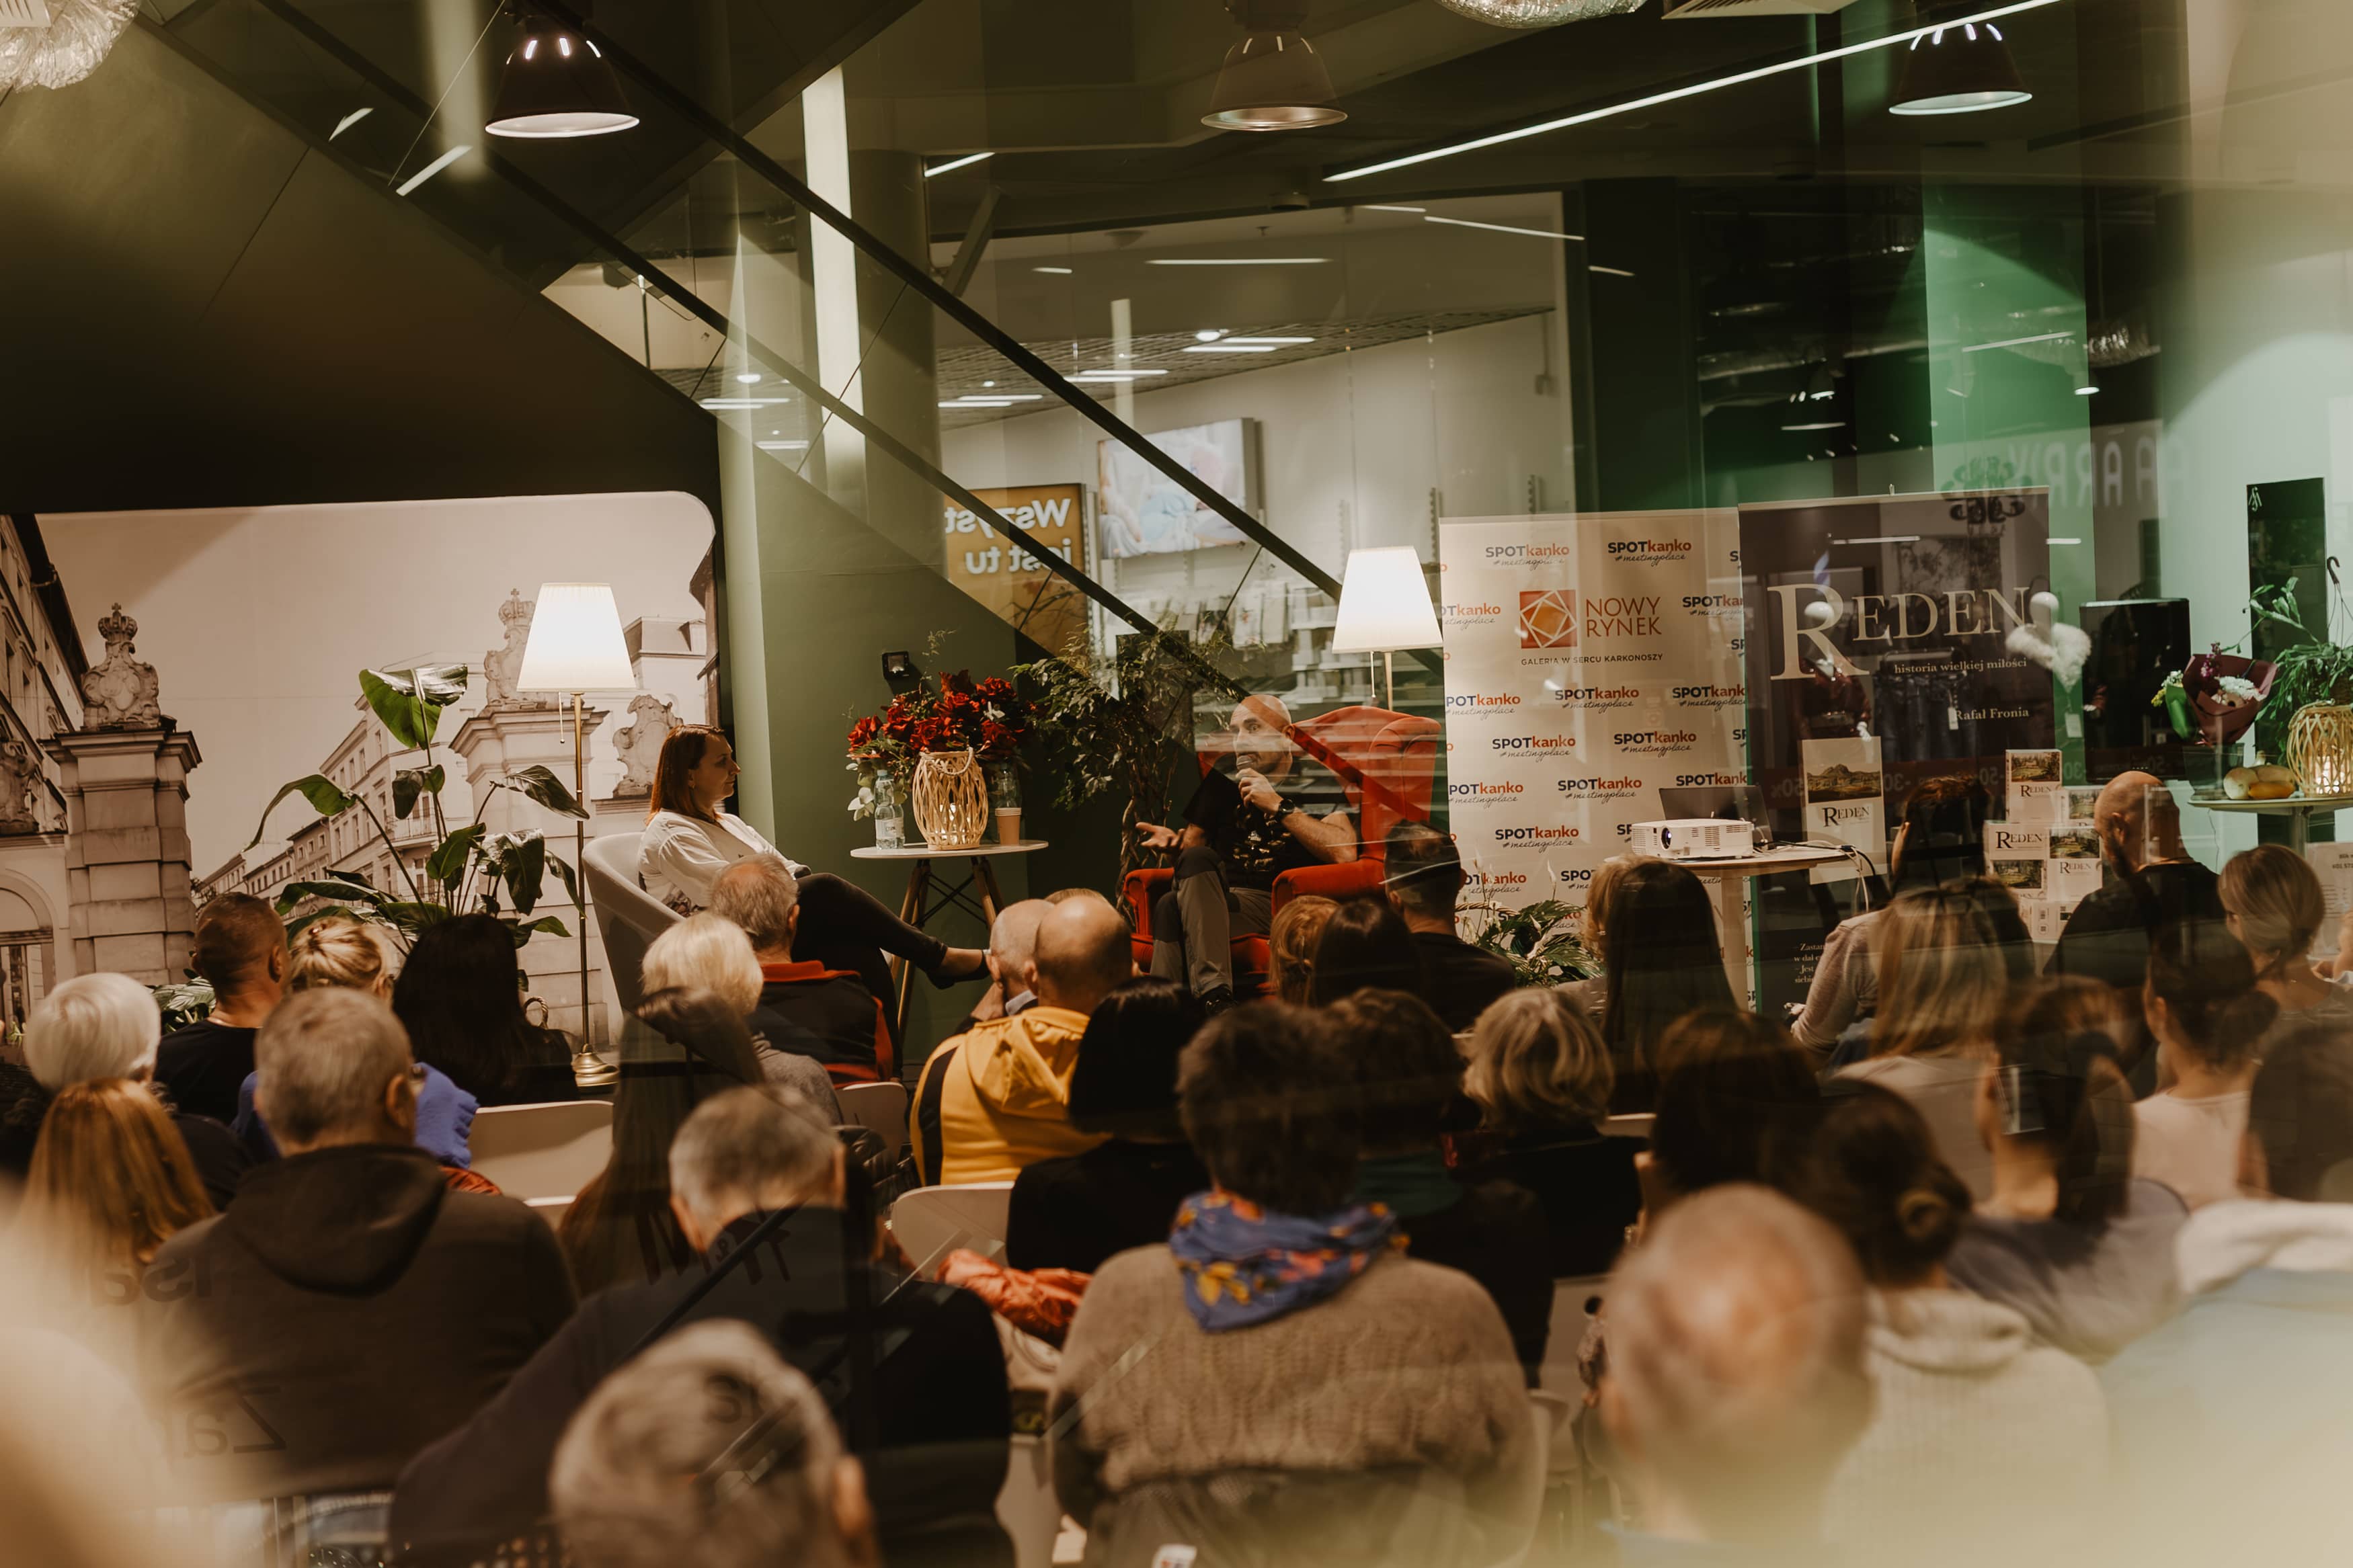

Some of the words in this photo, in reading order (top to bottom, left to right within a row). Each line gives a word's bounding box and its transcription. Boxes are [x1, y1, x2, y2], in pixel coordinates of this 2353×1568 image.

[1485, 543, 1570, 558] SPOTkanko
[1608, 538, 1691, 554] SPOTkanko
[1615, 550, 1687, 567] #meetingplace
[1586, 596, 1661, 618] NOWY
[1682, 594, 1743, 608] SPOTka
[1441, 602, 1501, 616] OTkanko
[1587, 616, 1663, 638] RYNEK
[1767, 583, 2030, 681] REDEN
[1521, 657, 1559, 666] GALERIA
[1573, 655, 1602, 664] SERCU
[1604, 653, 1664, 663] KARKONOSZY
[1894, 663, 1937, 674] historia
[1940, 660, 1984, 672] wielkiej
[1987, 657, 2027, 669] miłości
[1555, 686, 1640, 700] SPOTkanko
[1672, 684, 1745, 698] SPOTkank
[1446, 693, 1521, 706] POTkanko
[1562, 697, 1634, 714] #meetingplace
[1679, 695, 1746, 712] #meetingplac
[1990, 706, 2029, 718] Fronia
[1492, 735, 1576, 749] SPOTkanko
[1614, 730, 1697, 745] SPOTkanko
[1499, 747, 1571, 763] #meetingplace
[1622, 741, 1691, 758] #meetingplace
[1558, 776, 1642, 791] SPOTkanko
[1676, 771, 1747, 786] SPOTkank
[1449, 781, 1523, 795] POTkanko
[1565, 788, 1636, 804] #meetingplace
[1822, 807, 1870, 827] REDEN
[1495, 825, 1579, 840] SPOTkanko
[1995, 831, 2043, 849] REDEN
[1503, 837, 1574, 854] #meetingplace
[1464, 871, 1527, 885] OTkanko
